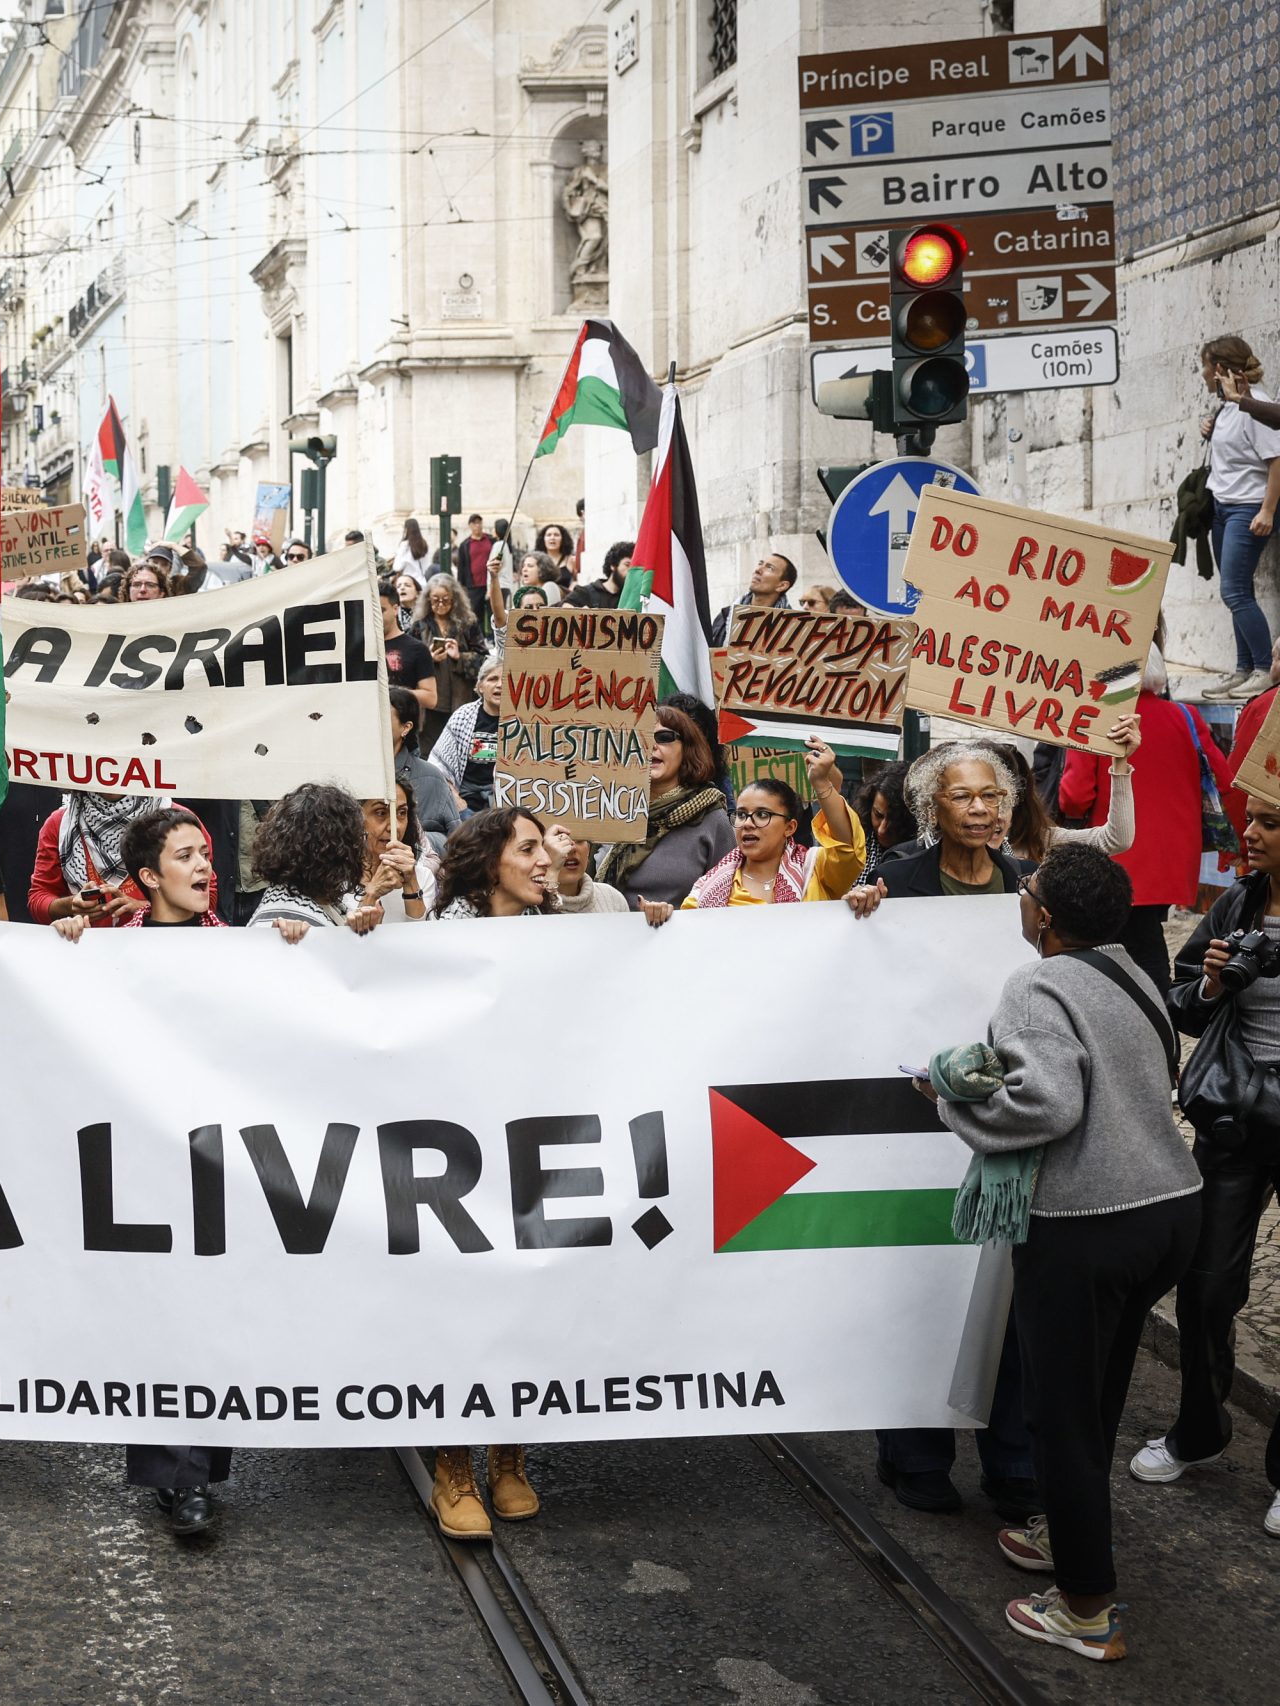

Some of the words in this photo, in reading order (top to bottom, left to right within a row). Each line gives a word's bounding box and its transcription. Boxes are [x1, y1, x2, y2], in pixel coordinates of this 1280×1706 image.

[801, 65, 910, 93] Príncipe
[930, 55, 990, 81] Real
[932, 117, 1006, 137] Parque
[1020, 107, 1107, 129] Camões
[883, 173, 1000, 206] Bairro
[1027, 162, 1108, 194] Alto
[993, 227, 1110, 254] Catarina
[812, 303, 838, 326] S.
[856, 300, 891, 322] Ca
[1031, 338, 1103, 358] Camões
[1042, 358, 1093, 380] (10m)
[1, 538, 18, 553] TOP
[28, 531, 66, 549] UNTIL
[15, 510, 63, 534] WONT
[1, 553, 27, 569] STINE
[29, 551, 42, 565] IS
[46, 544, 81, 561] FREE
[930, 515, 980, 557] DO
[1008, 536, 1086, 587] RIO
[514, 614, 658, 651] SIONISMO
[954, 576, 1010, 613] AO
[1039, 596, 1132, 646] MAR
[4, 626, 72, 683] A
[83, 600, 378, 691] ISRAEL
[571, 650, 582, 670] É
[729, 611, 901, 670] INTIFADA
[507, 667, 657, 718] VIOLÊNCIA
[724, 659, 906, 722] REVOLUTION
[948, 677, 1101, 745] LIVRE
[499, 718, 646, 767] PALESTINA
[495, 772, 650, 822] RESISTÊNCIA
[77, 1110, 675, 1257] LIVRE!
[335, 1382, 445, 1420] COM
[461, 1382, 496, 1418] A
[512, 1369, 786, 1418] PALESTINA
